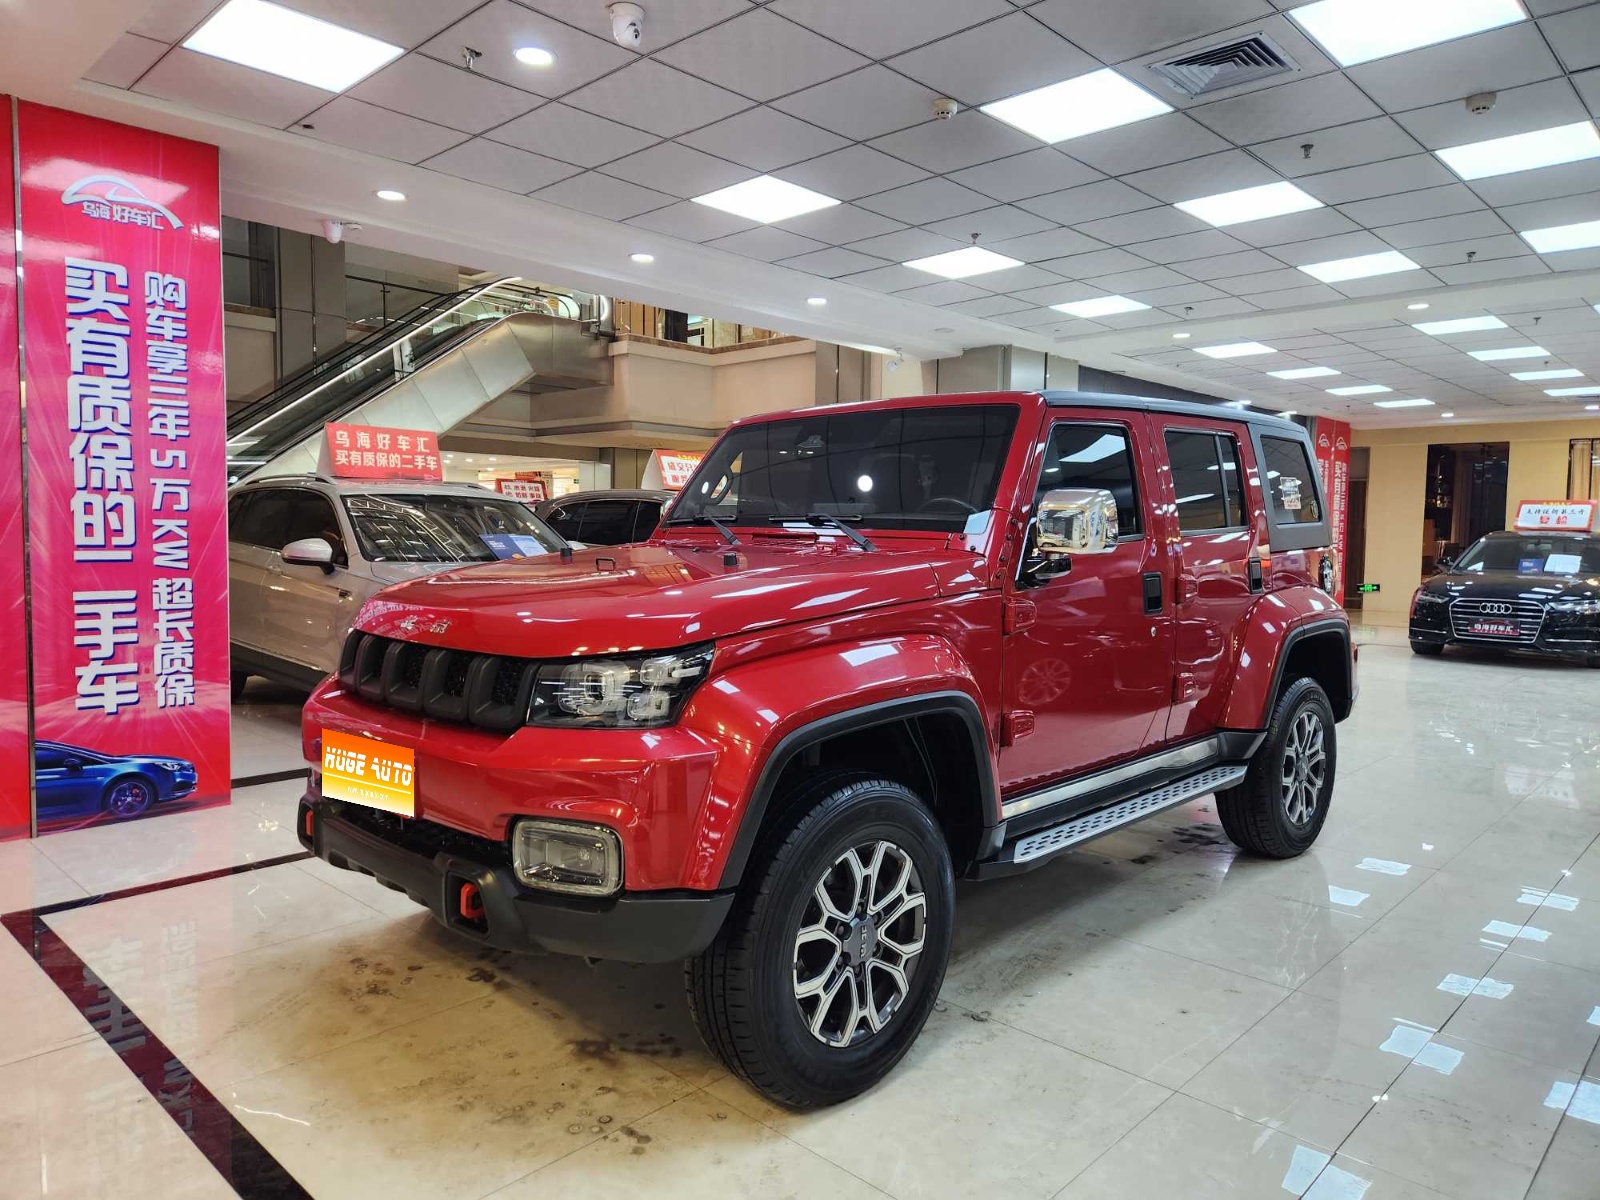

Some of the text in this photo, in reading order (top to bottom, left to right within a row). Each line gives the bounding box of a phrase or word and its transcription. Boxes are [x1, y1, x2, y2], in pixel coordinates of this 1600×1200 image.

[335, 430, 430, 453] 乌海好车汇
[335, 449, 438, 470] 买有质保的二手车
[64, 257, 139, 715] 买有质保的二手车
